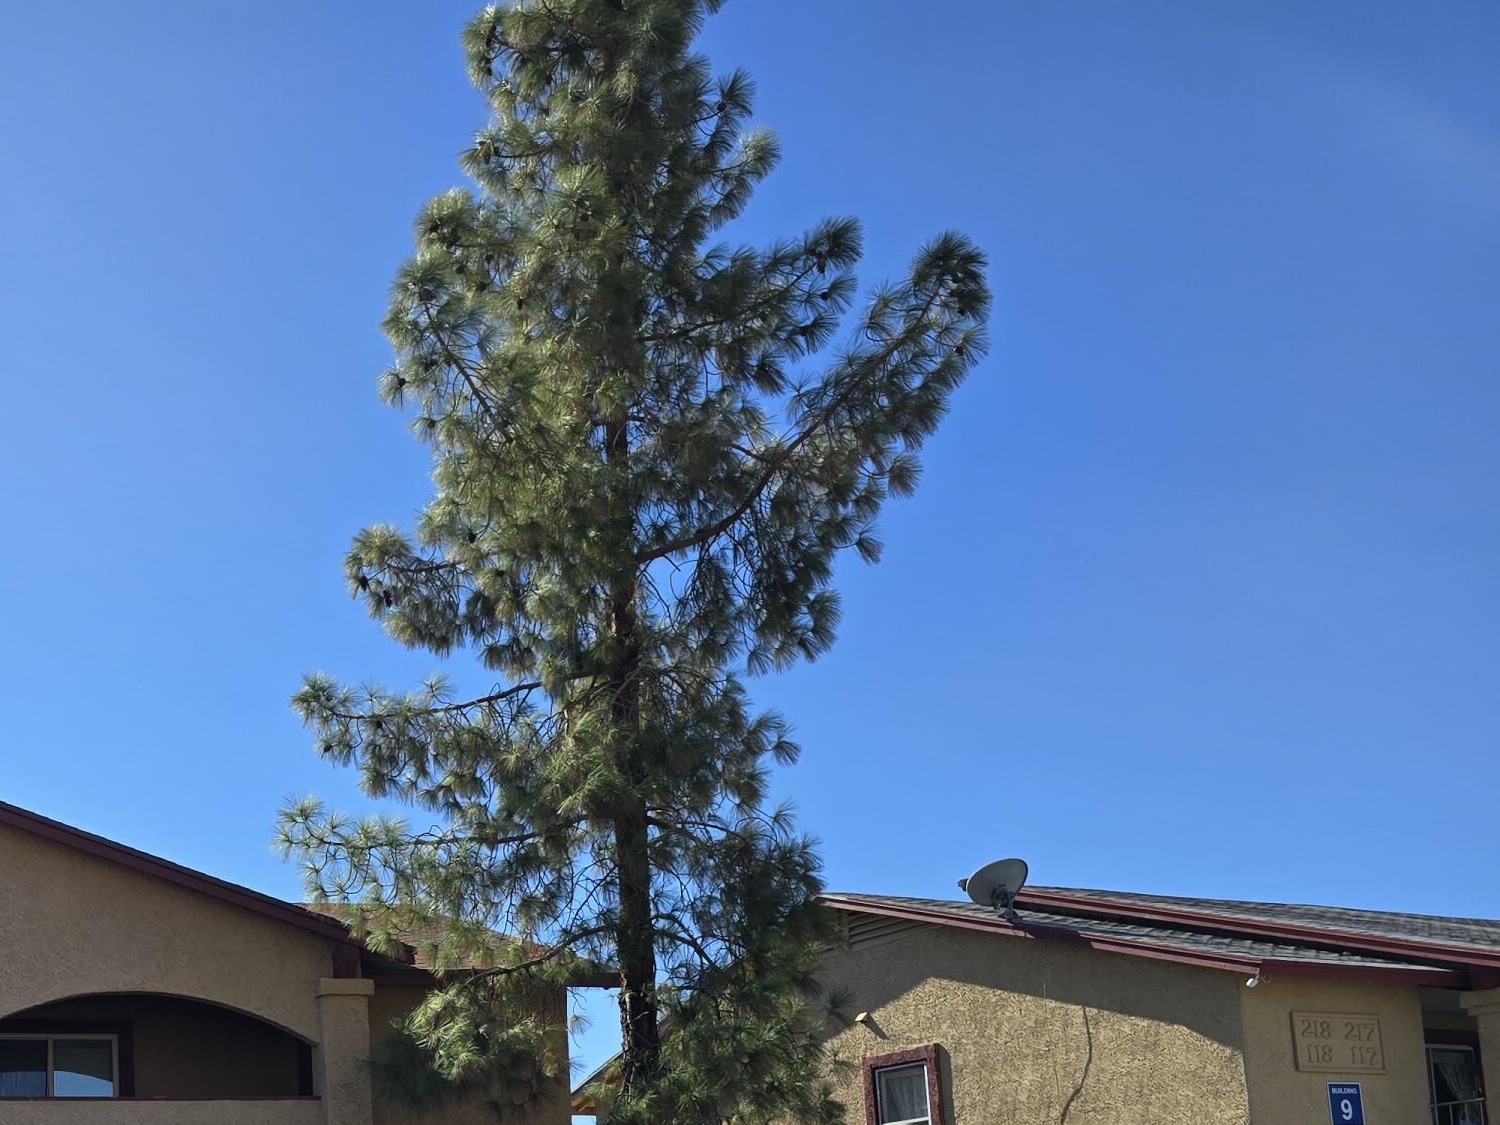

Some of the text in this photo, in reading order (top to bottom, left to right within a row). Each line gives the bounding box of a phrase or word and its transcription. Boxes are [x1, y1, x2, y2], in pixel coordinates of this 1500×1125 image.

[1301, 1019, 1375, 1042] 218 217
[1306, 1044, 1379, 1066] 118 117
[1340, 1099, 1353, 1121] 9
